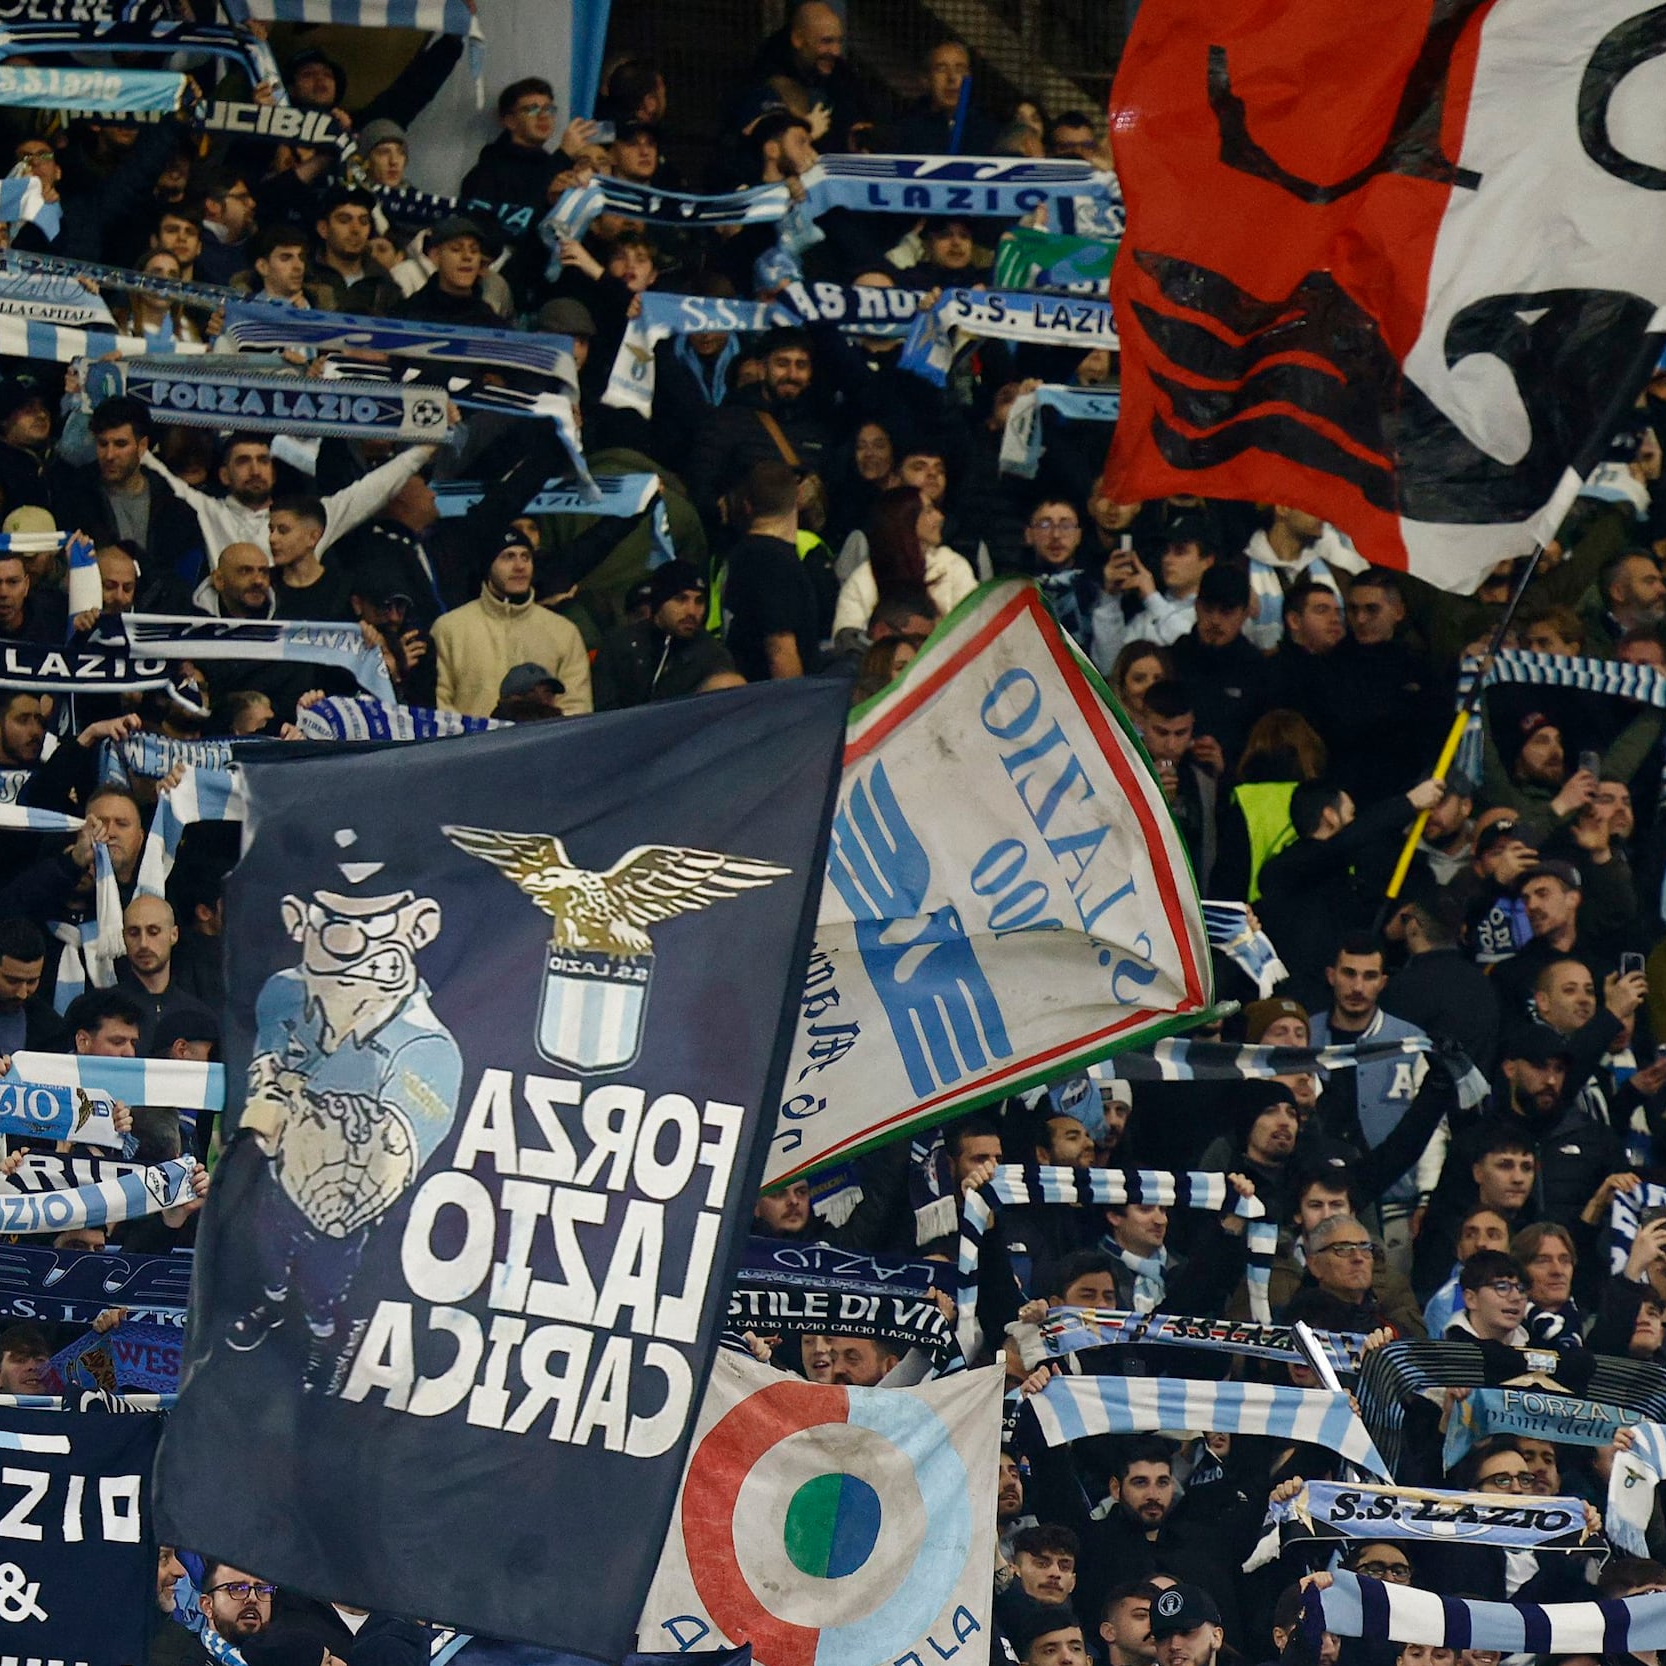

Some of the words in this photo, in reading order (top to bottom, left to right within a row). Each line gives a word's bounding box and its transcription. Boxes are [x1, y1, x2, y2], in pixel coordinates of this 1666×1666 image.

[957, 296, 1018, 327] S.S.
[153, 381, 267, 419] FORZA
[272, 392, 383, 423] LAZIO
[5, 647, 169, 681] LAZIO
[726, 1290, 831, 1320] STILE
[838, 1292, 881, 1322] DI
[1330, 1492, 1412, 1527] S.S.
[1420, 1501, 1574, 1535] LAZIO
